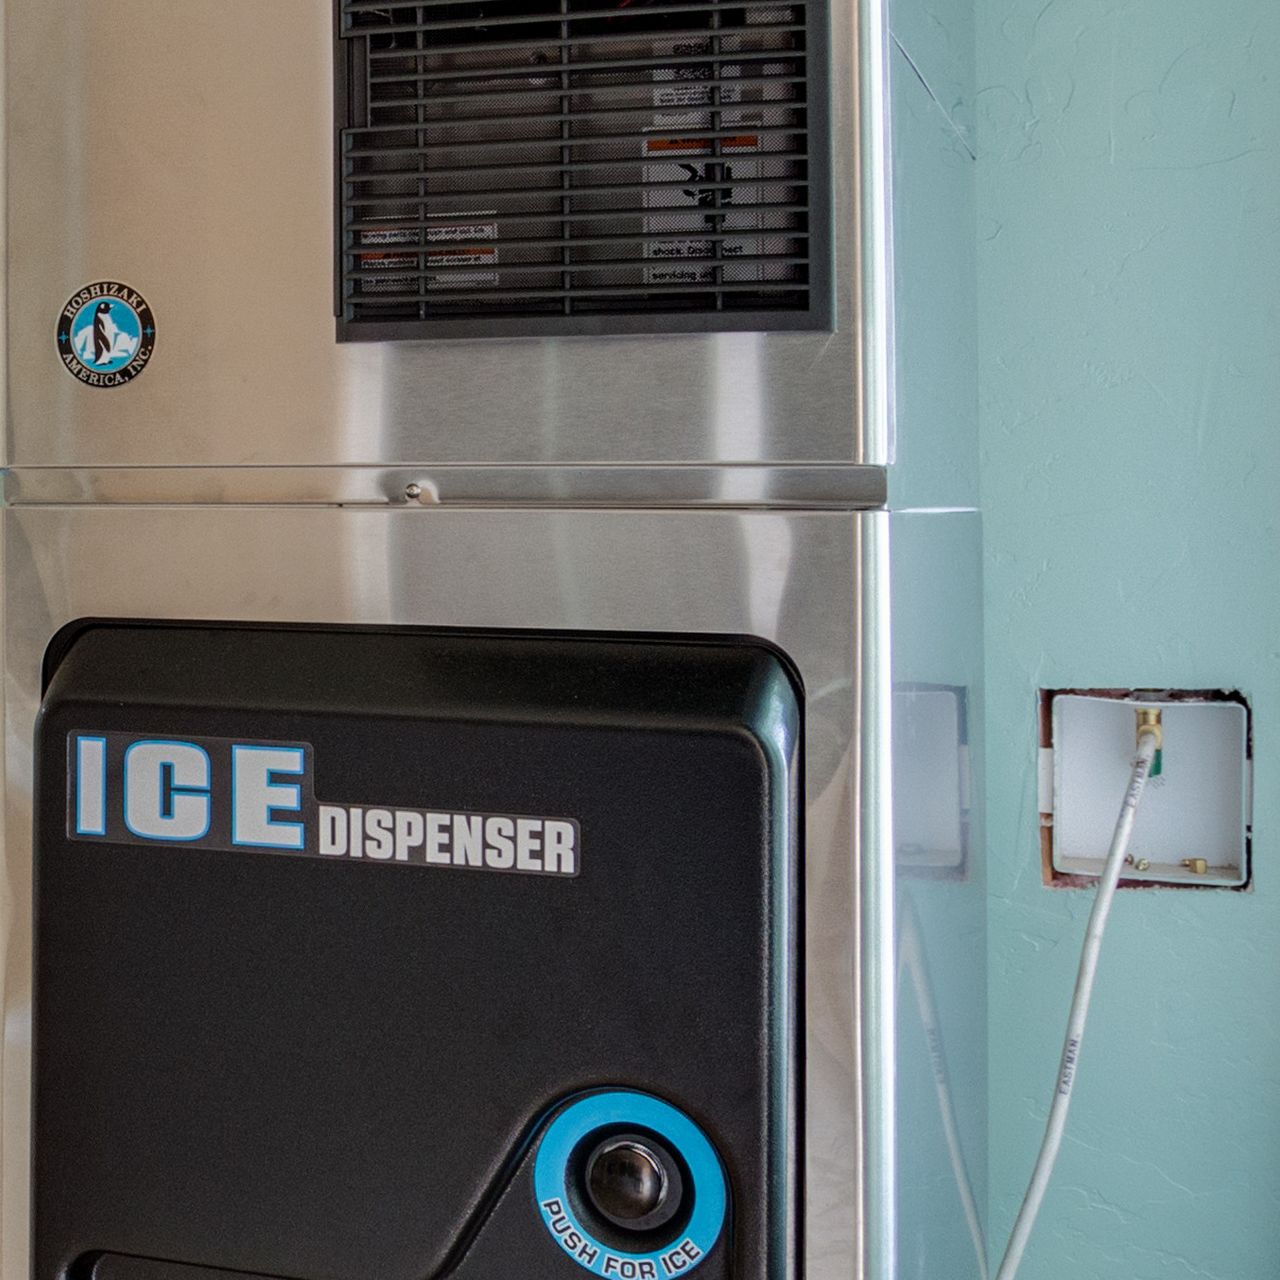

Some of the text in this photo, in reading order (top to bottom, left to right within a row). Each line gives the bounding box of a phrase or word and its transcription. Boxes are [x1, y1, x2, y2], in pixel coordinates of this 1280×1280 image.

[63, 283, 147, 319] HOSHIZAKI
[63, 345, 153, 386] AMERICA, INC.
[76, 736, 575, 874] ICE DISPENSER
[541, 1197, 704, 1280] PUSH FOR ICE
